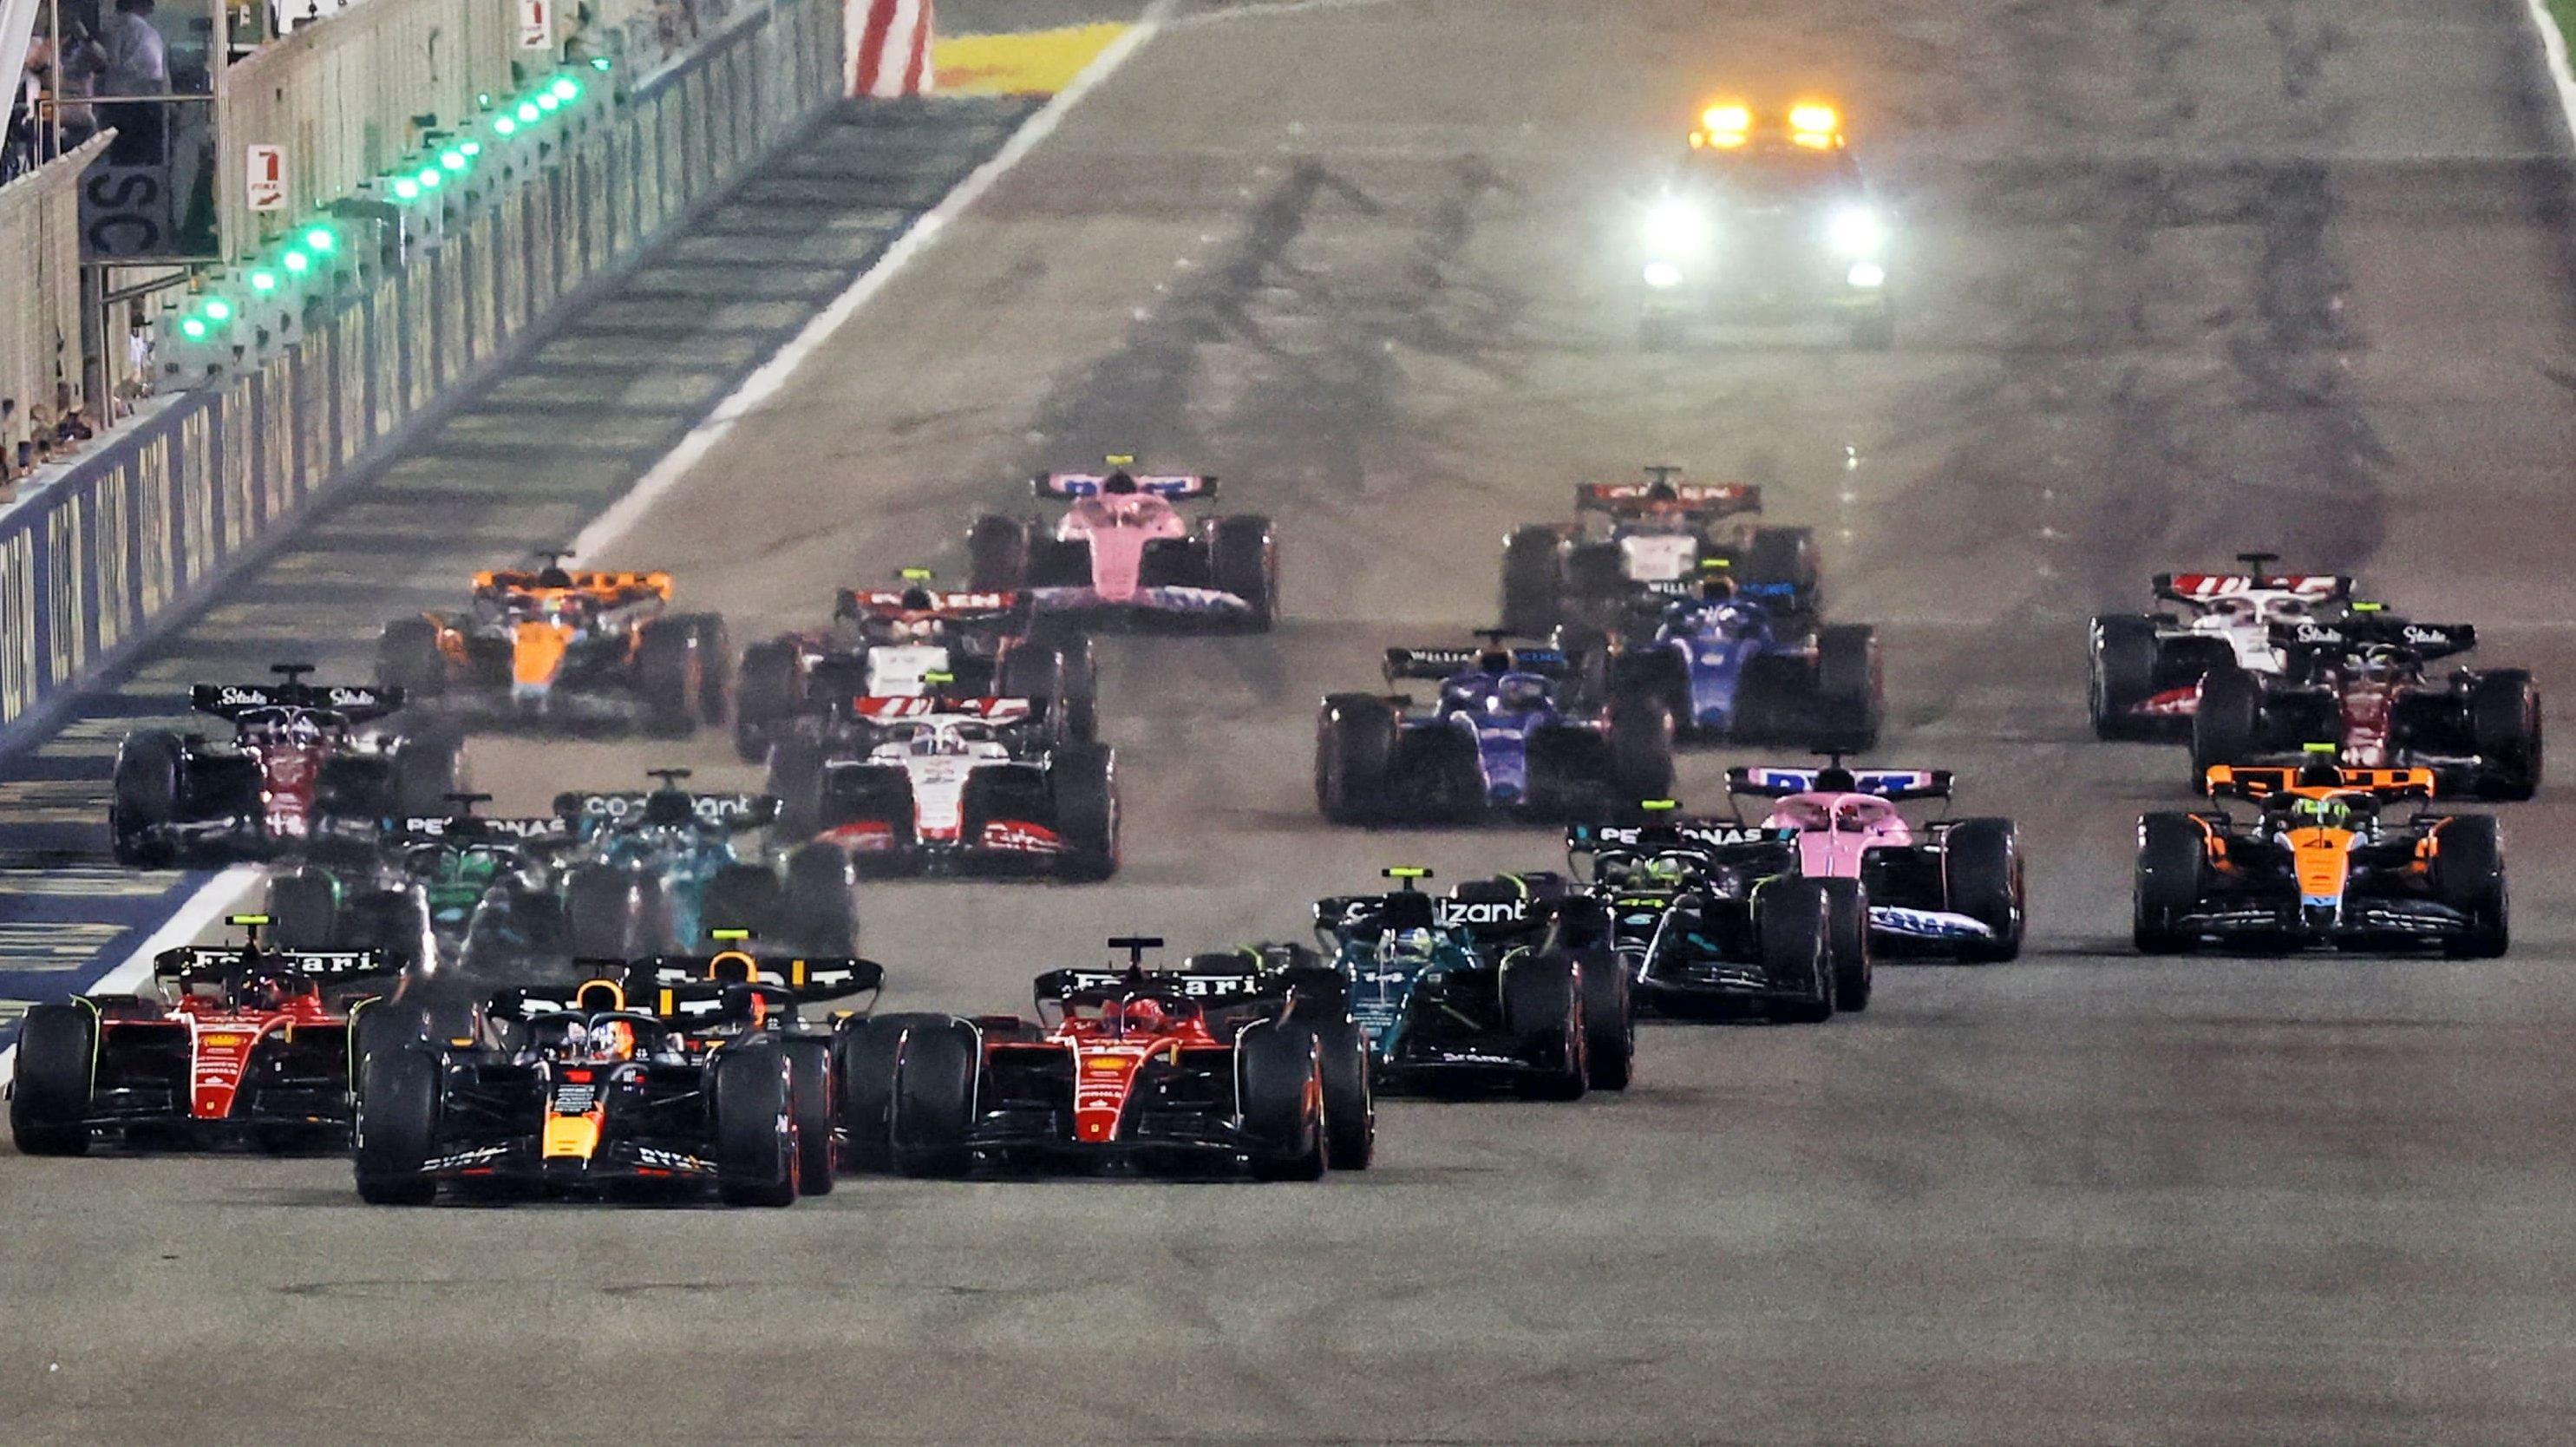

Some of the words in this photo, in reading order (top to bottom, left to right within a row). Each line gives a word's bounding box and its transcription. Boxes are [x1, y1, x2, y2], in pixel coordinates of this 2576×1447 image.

[88, 174, 158, 253] SC
[585, 793, 749, 817] coant
[407, 816, 565, 837] PENAS
[1601, 827, 1762, 846] PENAS
[1345, 899, 1529, 923] cizant
[192, 951, 378, 972] Fari
[1074, 973, 1257, 995] Fari
